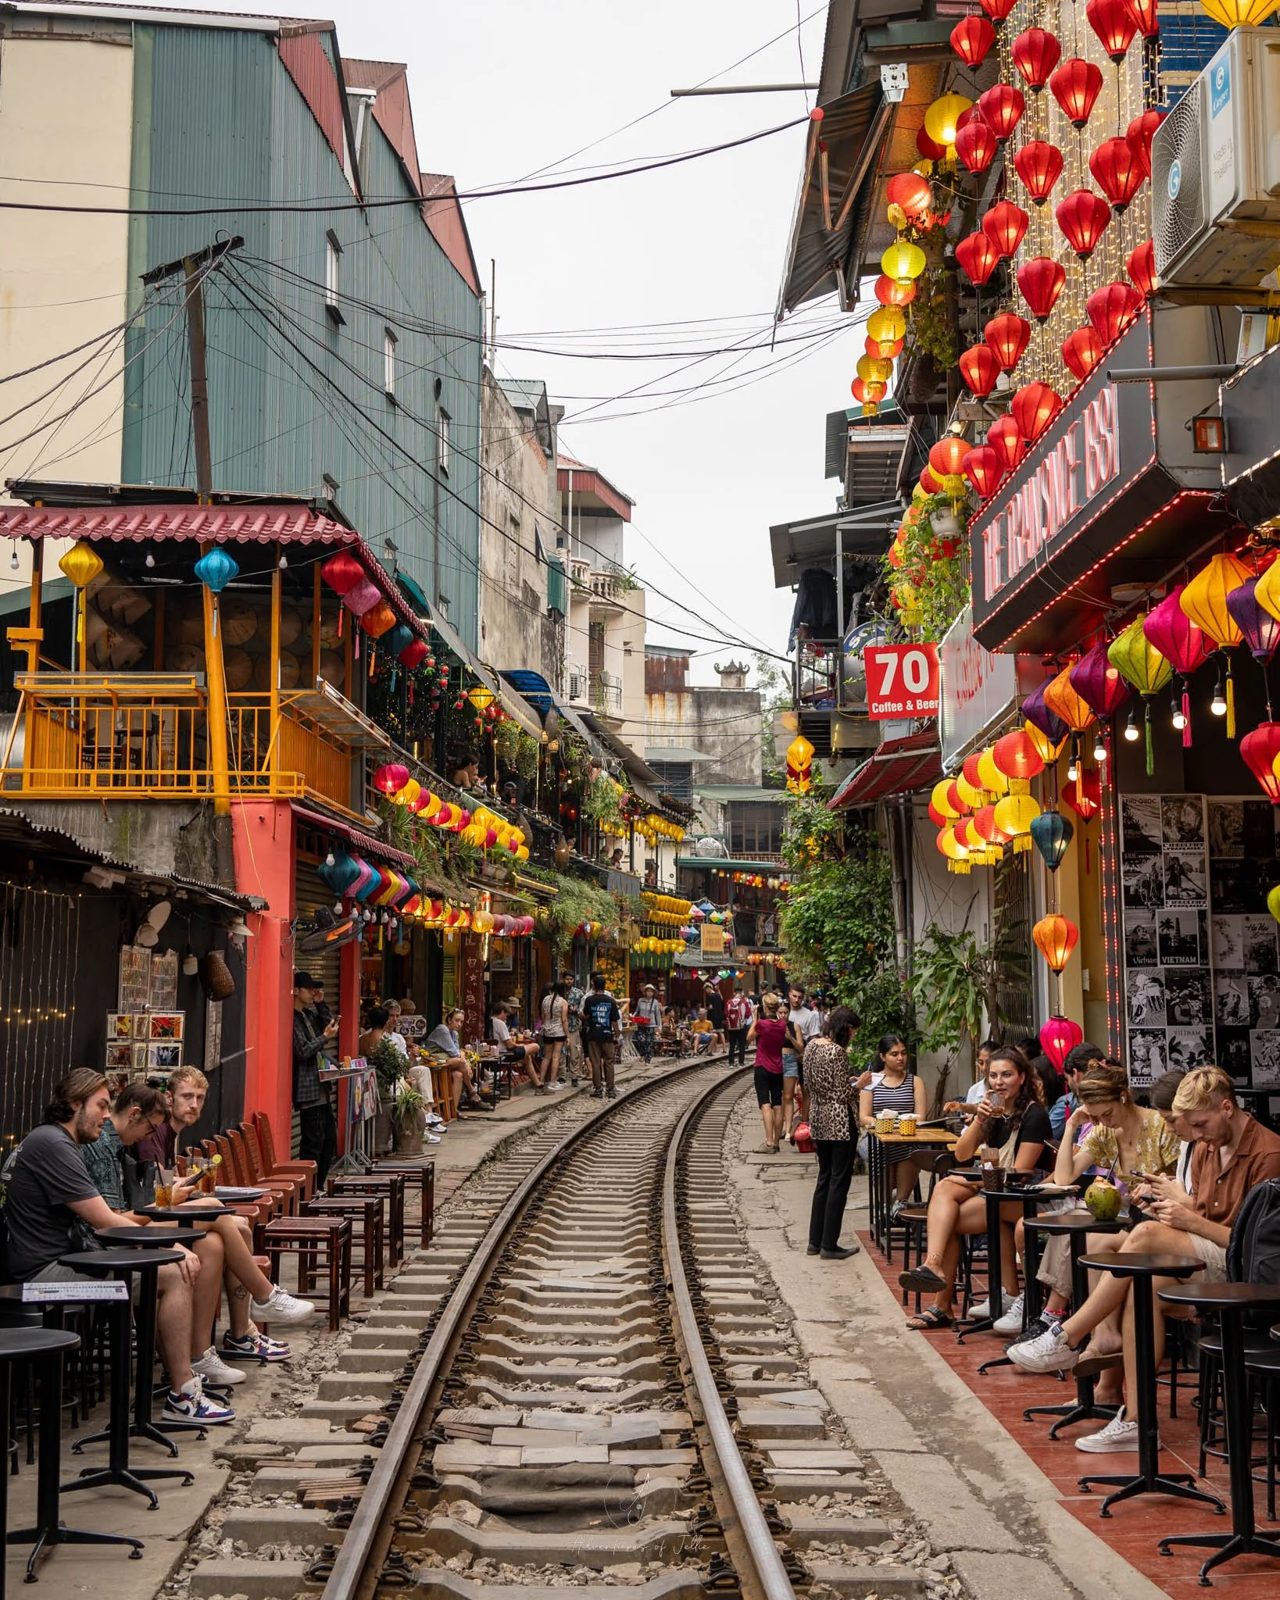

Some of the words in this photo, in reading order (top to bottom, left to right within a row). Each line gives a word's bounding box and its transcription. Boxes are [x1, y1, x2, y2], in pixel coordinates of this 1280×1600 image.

[875, 650, 929, 696] 70
[872, 701, 903, 713] Coffee
[906, 700, 914, 711] &
[1162, 956, 1197, 964] VIETNAM
